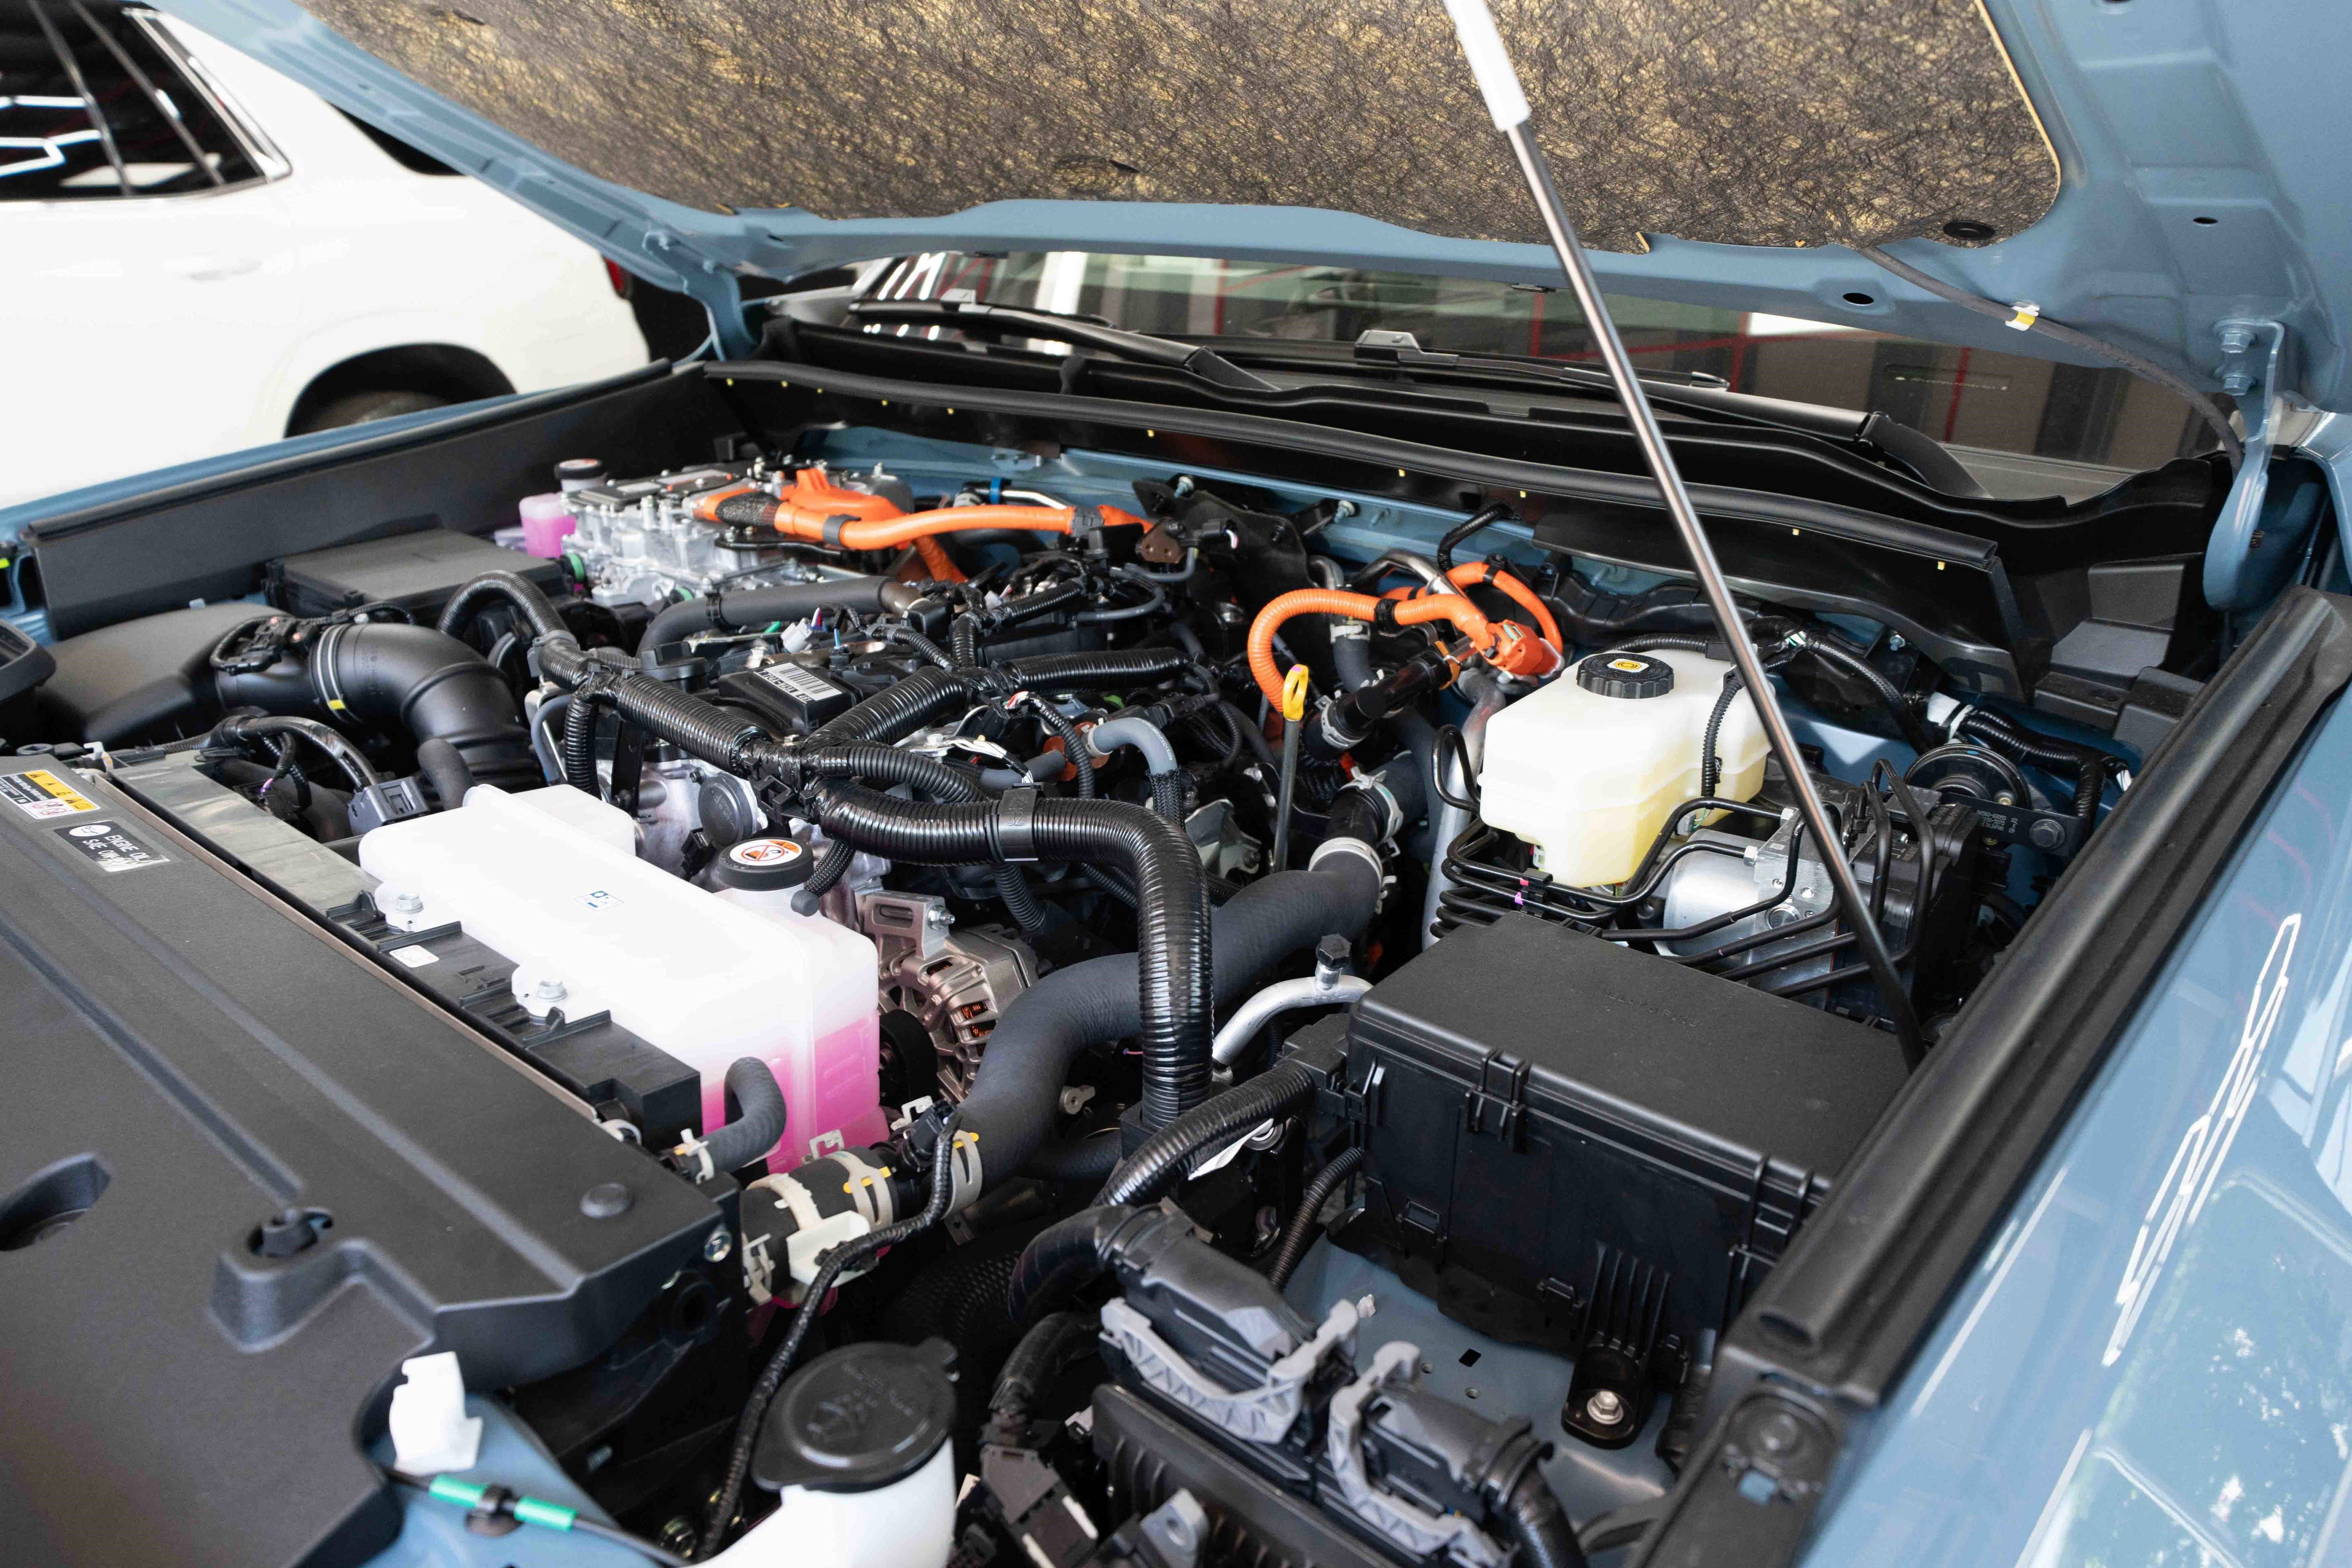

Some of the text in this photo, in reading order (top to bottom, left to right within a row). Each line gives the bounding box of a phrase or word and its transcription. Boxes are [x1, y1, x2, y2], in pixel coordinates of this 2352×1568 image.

[1006, 811, 1024, 826] 32
[82, 838, 108, 850] SAE
[104, 835, 151, 862] ENGINE OIL
